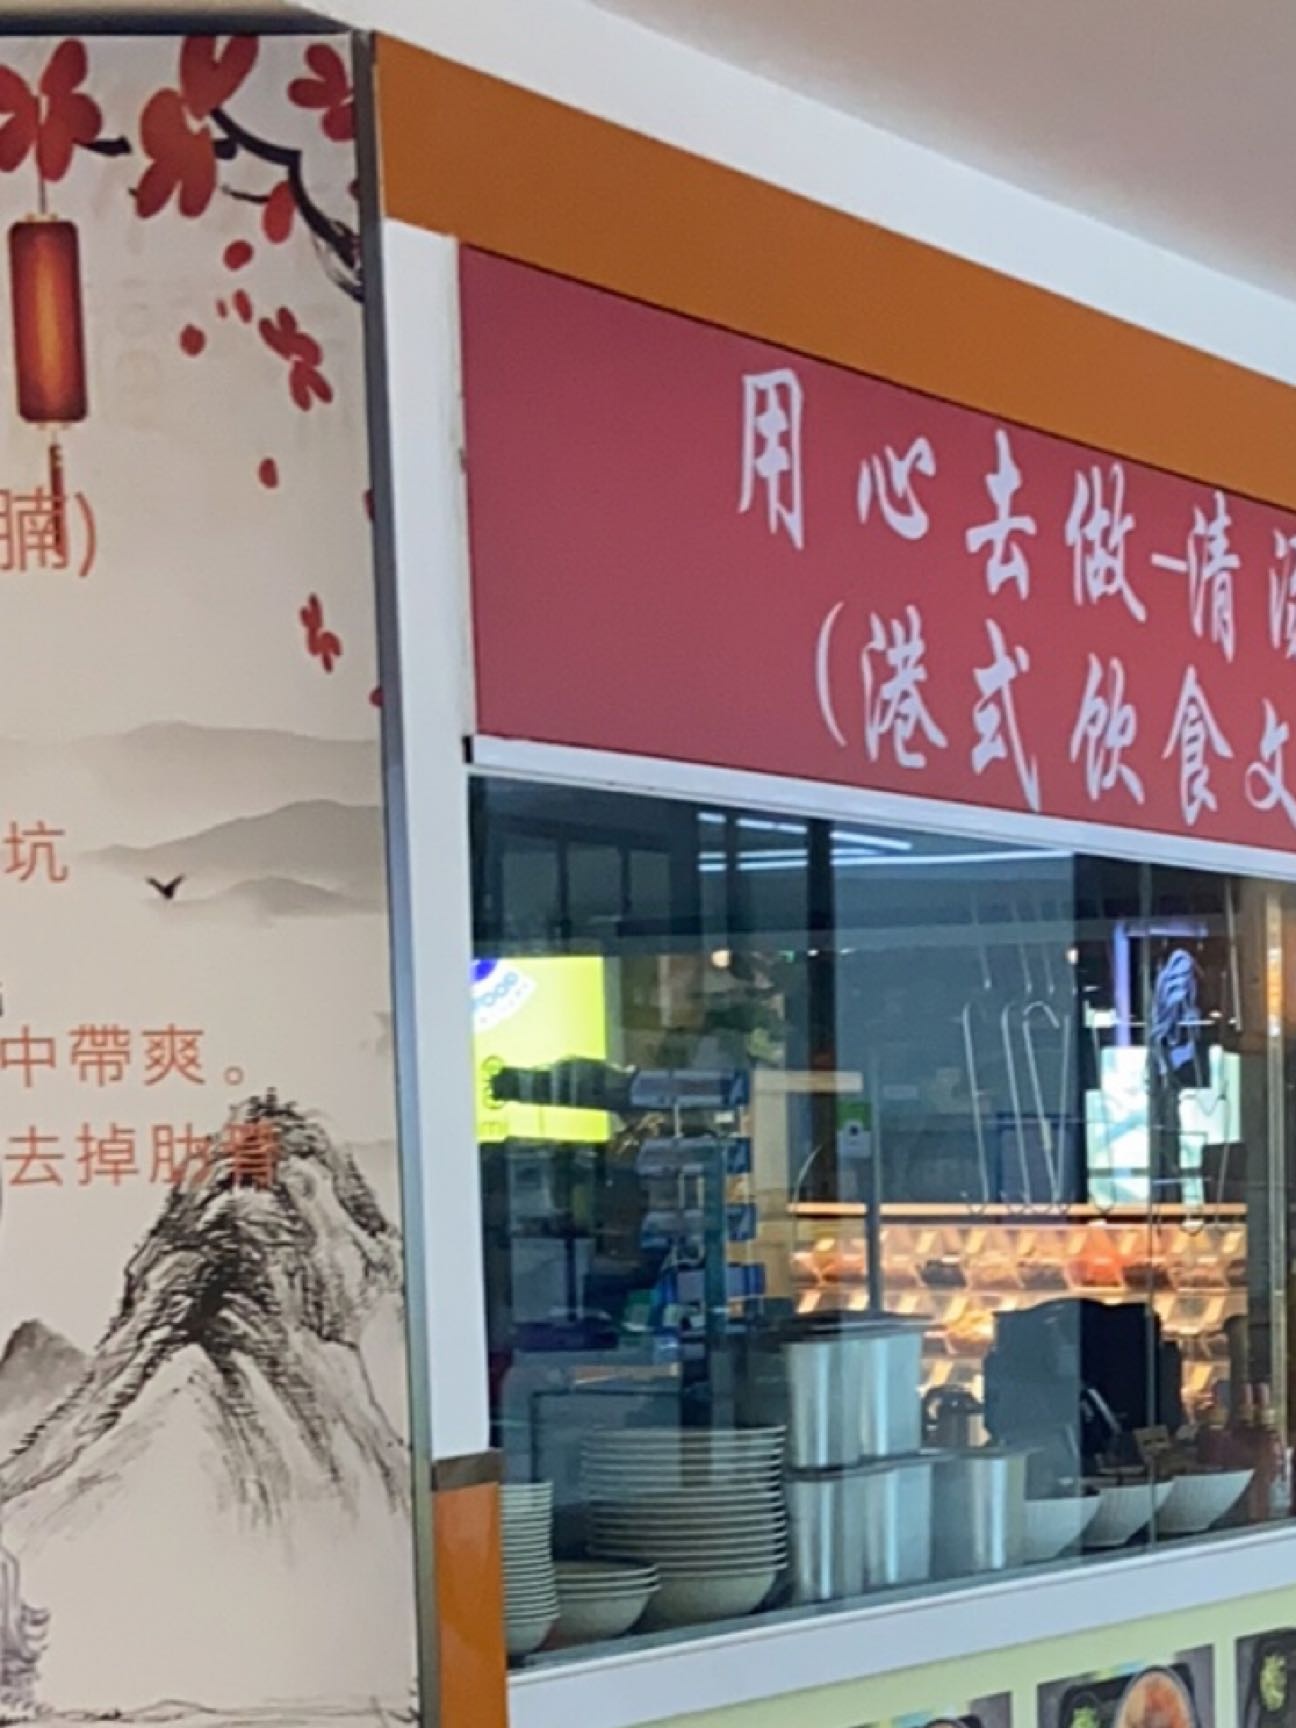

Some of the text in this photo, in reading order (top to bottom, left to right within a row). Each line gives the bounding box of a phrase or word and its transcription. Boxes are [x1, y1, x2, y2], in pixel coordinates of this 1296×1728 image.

[3, 820, 69, 882] 坑
[0, 1023, 244, 1087] 中帶爽。
